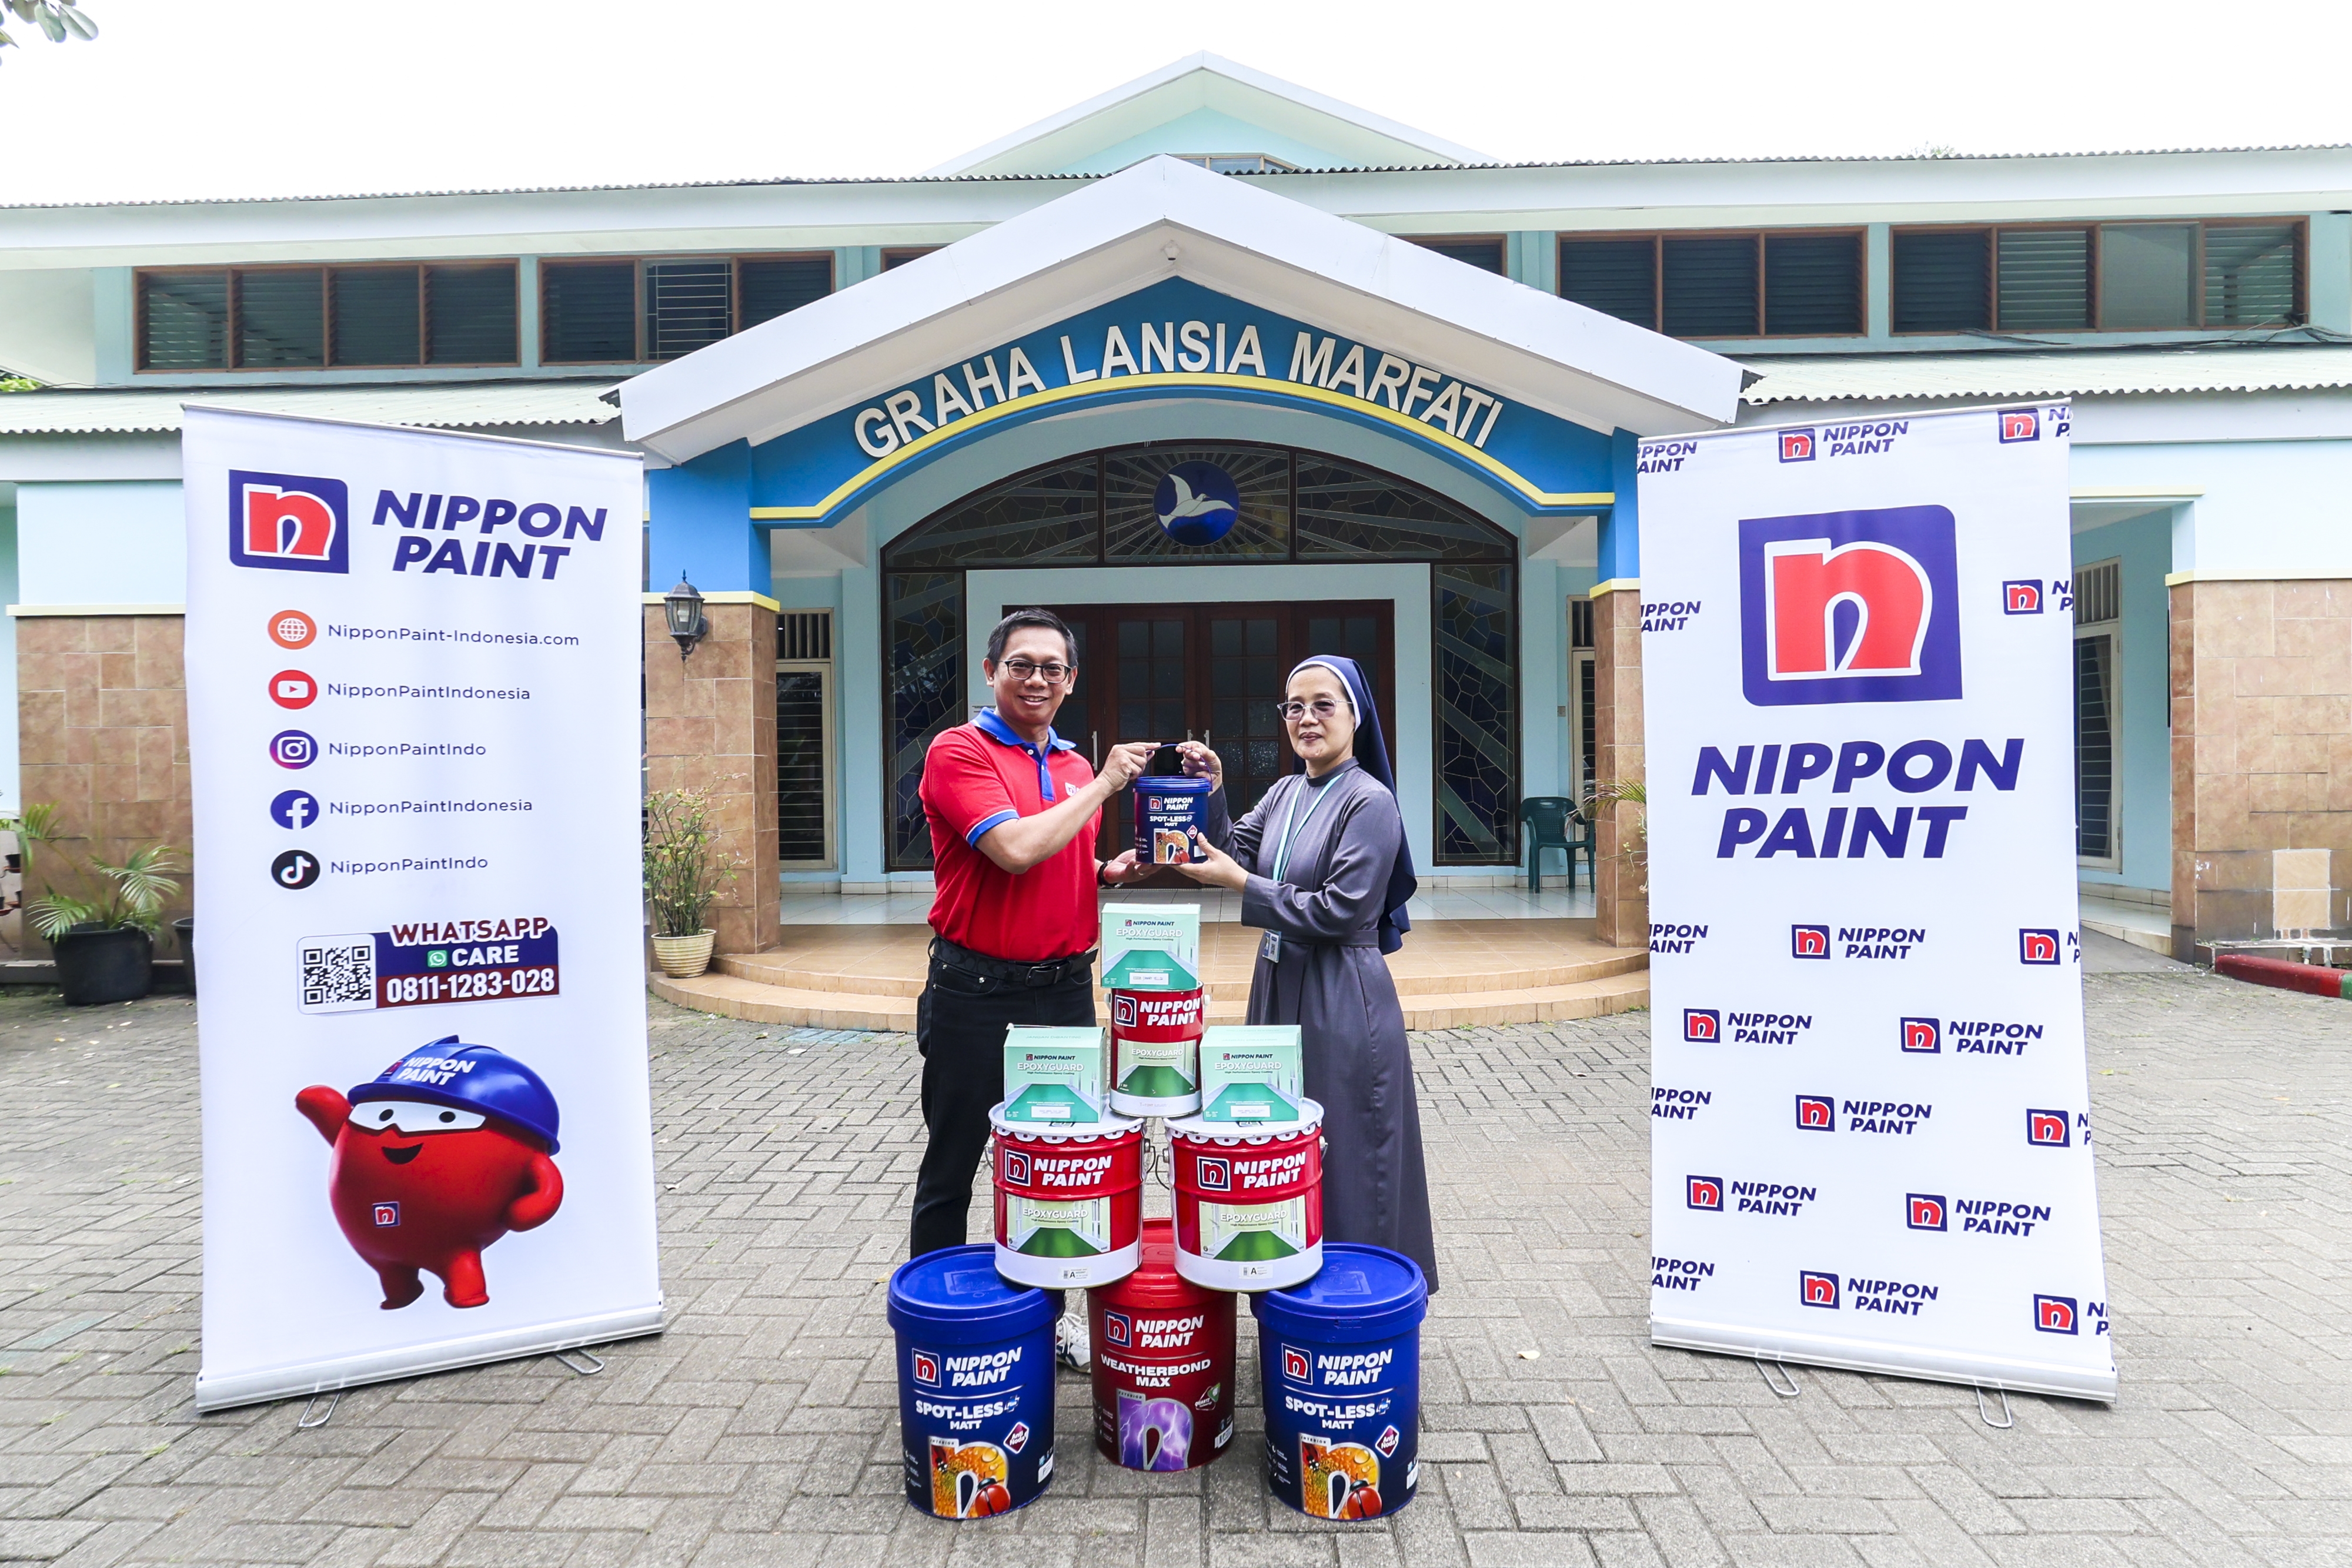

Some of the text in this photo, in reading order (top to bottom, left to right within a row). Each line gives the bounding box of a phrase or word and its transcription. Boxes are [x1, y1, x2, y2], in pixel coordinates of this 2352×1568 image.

[853, 320, 1503, 460] GRAHA LANSIA MARFATI
[1823, 422, 1908, 442] NIPPON
[1830, 439, 1893, 457] PAINT
[372, 490, 608, 541] NIPPON
[392, 536, 571, 580] PAINT
[328, 624, 579, 646] NipponPaint-Indonesia.com
[328, 683, 530, 700] NipponPaintIndonesia
[329, 743, 487, 758] NipponPaintIndo
[1691, 738, 2024, 795] NIPPON
[330, 799, 533, 815] NipponPaintIndonesia
[1716, 805, 1969, 858] PAINT
[330, 857, 488, 875] NipponPaintIndo
[391, 917, 549, 944] WHATSAPP
[1116, 928, 1183, 937] EPOXYGUARD
[1838, 928, 1926, 942] NIPPON
[452, 945, 519, 967] CARE
[1845, 944, 1911, 959] PAINT
[386, 968, 555, 1003] 0811-1283-028
[1140, 998, 1200, 1013] NIPPON
[1147, 1011, 1197, 1026] PAINT
[1728, 1012, 1812, 1029] NIPPON
[1734, 1028, 1798, 1045] PAINT
[1949, 1021, 2043, 1039] NIPPON
[1131, 1048, 1184, 1057] EPOXYGUARD
[1956, 1038, 2028, 1056] PAINT
[403, 1057, 477, 1073] NIPPON
[1017, 1062, 1084, 1071] EPOXYGUARD
[1214, 1062, 1282, 1071] EPOXYGUARD
[396, 1068, 456, 1085] PAINT
[1842, 1100, 1932, 1119] NIPPON
[1850, 1118, 1917, 1135] PAINT
[1034, 1155, 1112, 1171] NIPPON
[1234, 1152, 1306, 1175] NIPPON
[1042, 1171, 1104, 1186] PAINT
[1243, 1168, 1301, 1189] PAINT
[1731, 1181, 1816, 1201] NIPPON
[1023, 1208, 1088, 1219] EPOXYGUARD
[1220, 1210, 1288, 1222] EPOXYGUARD
[1738, 1198, 1802, 1216] PAINT
[1955, 1199, 2051, 1221] NIPPON
[1963, 1218, 2035, 1236] PAINT
[1847, 1278, 1938, 1300] NIPPON
[1855, 1296, 1923, 1316] PAINT
[1135, 1315, 1204, 1333] NIPPON
[1141, 1332, 1193, 1348] PAINT
[946, 1347, 1022, 1371] NIPPON
[1101, 1353, 1211, 1376] WEATHERBOND
[1318, 1349, 1392, 1370] NIPPON
[951, 1366, 1010, 1386] PAINT
[1136, 1377, 1171, 1387] MAX
[1324, 1368, 1382, 1385] PAINT
[916, 1400, 1004, 1419] SPOT-LESS
[1285, 1396, 1375, 1419] SPOT-LESS
[950, 1420, 982, 1430] MATT
[1322, 1419, 1354, 1429] MATT
[1301, 1435, 1327, 1444] INTERIOR
[1381, 1440, 1396, 1449] Noda
[1383, 1435, 1394, 1443] Anti
